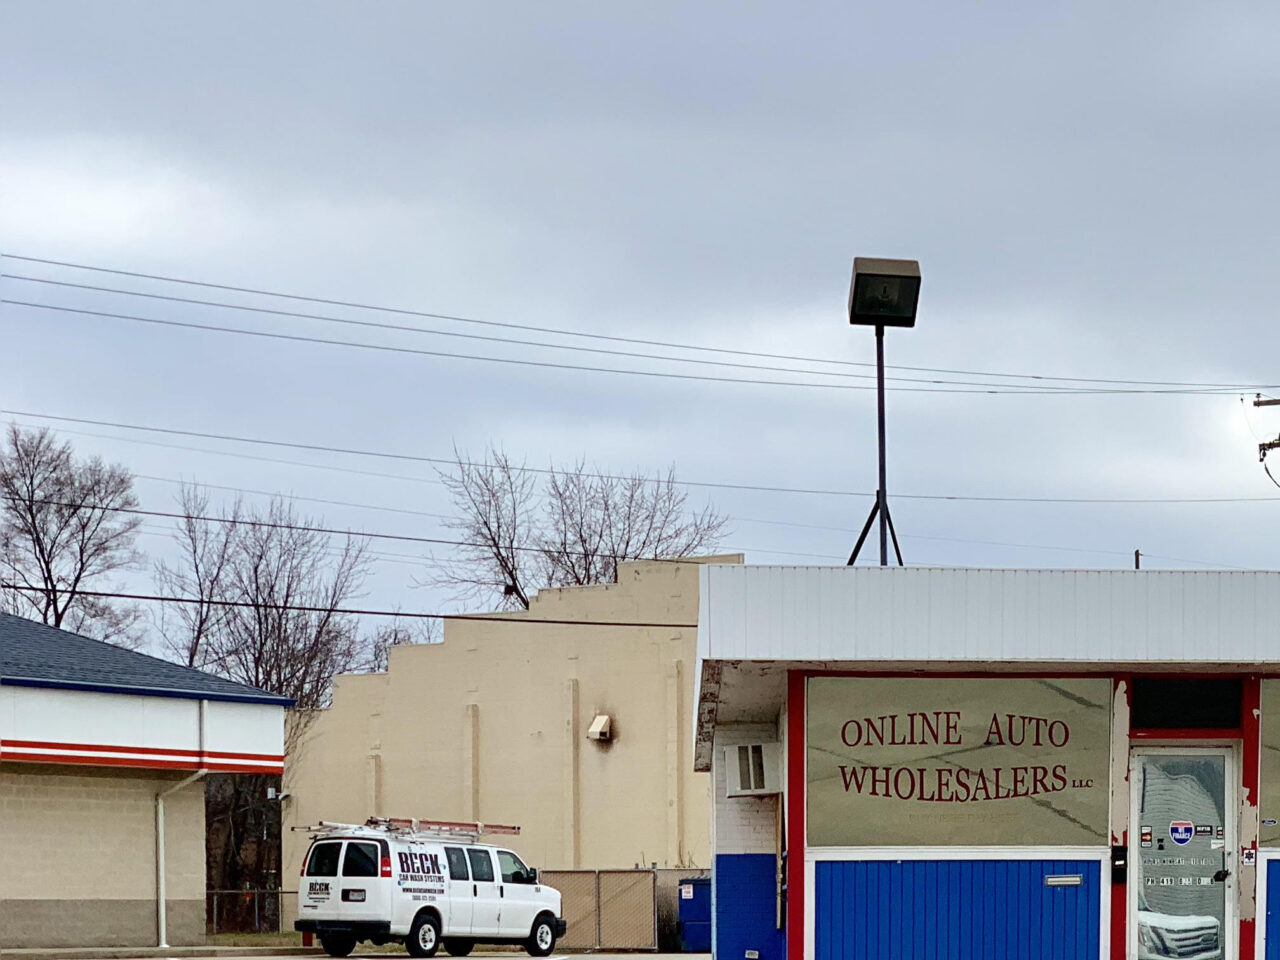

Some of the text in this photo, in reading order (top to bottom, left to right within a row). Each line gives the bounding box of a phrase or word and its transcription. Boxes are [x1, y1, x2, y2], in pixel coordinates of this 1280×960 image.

[841, 711, 1070, 748] ONLINE AUTO
[838, 764, 1094, 803] WHOLESALERS LLC
[397, 852, 442, 874] BECK
[309, 882, 330, 892] BECK
[424, 875, 445, 883] SYSTEMS
